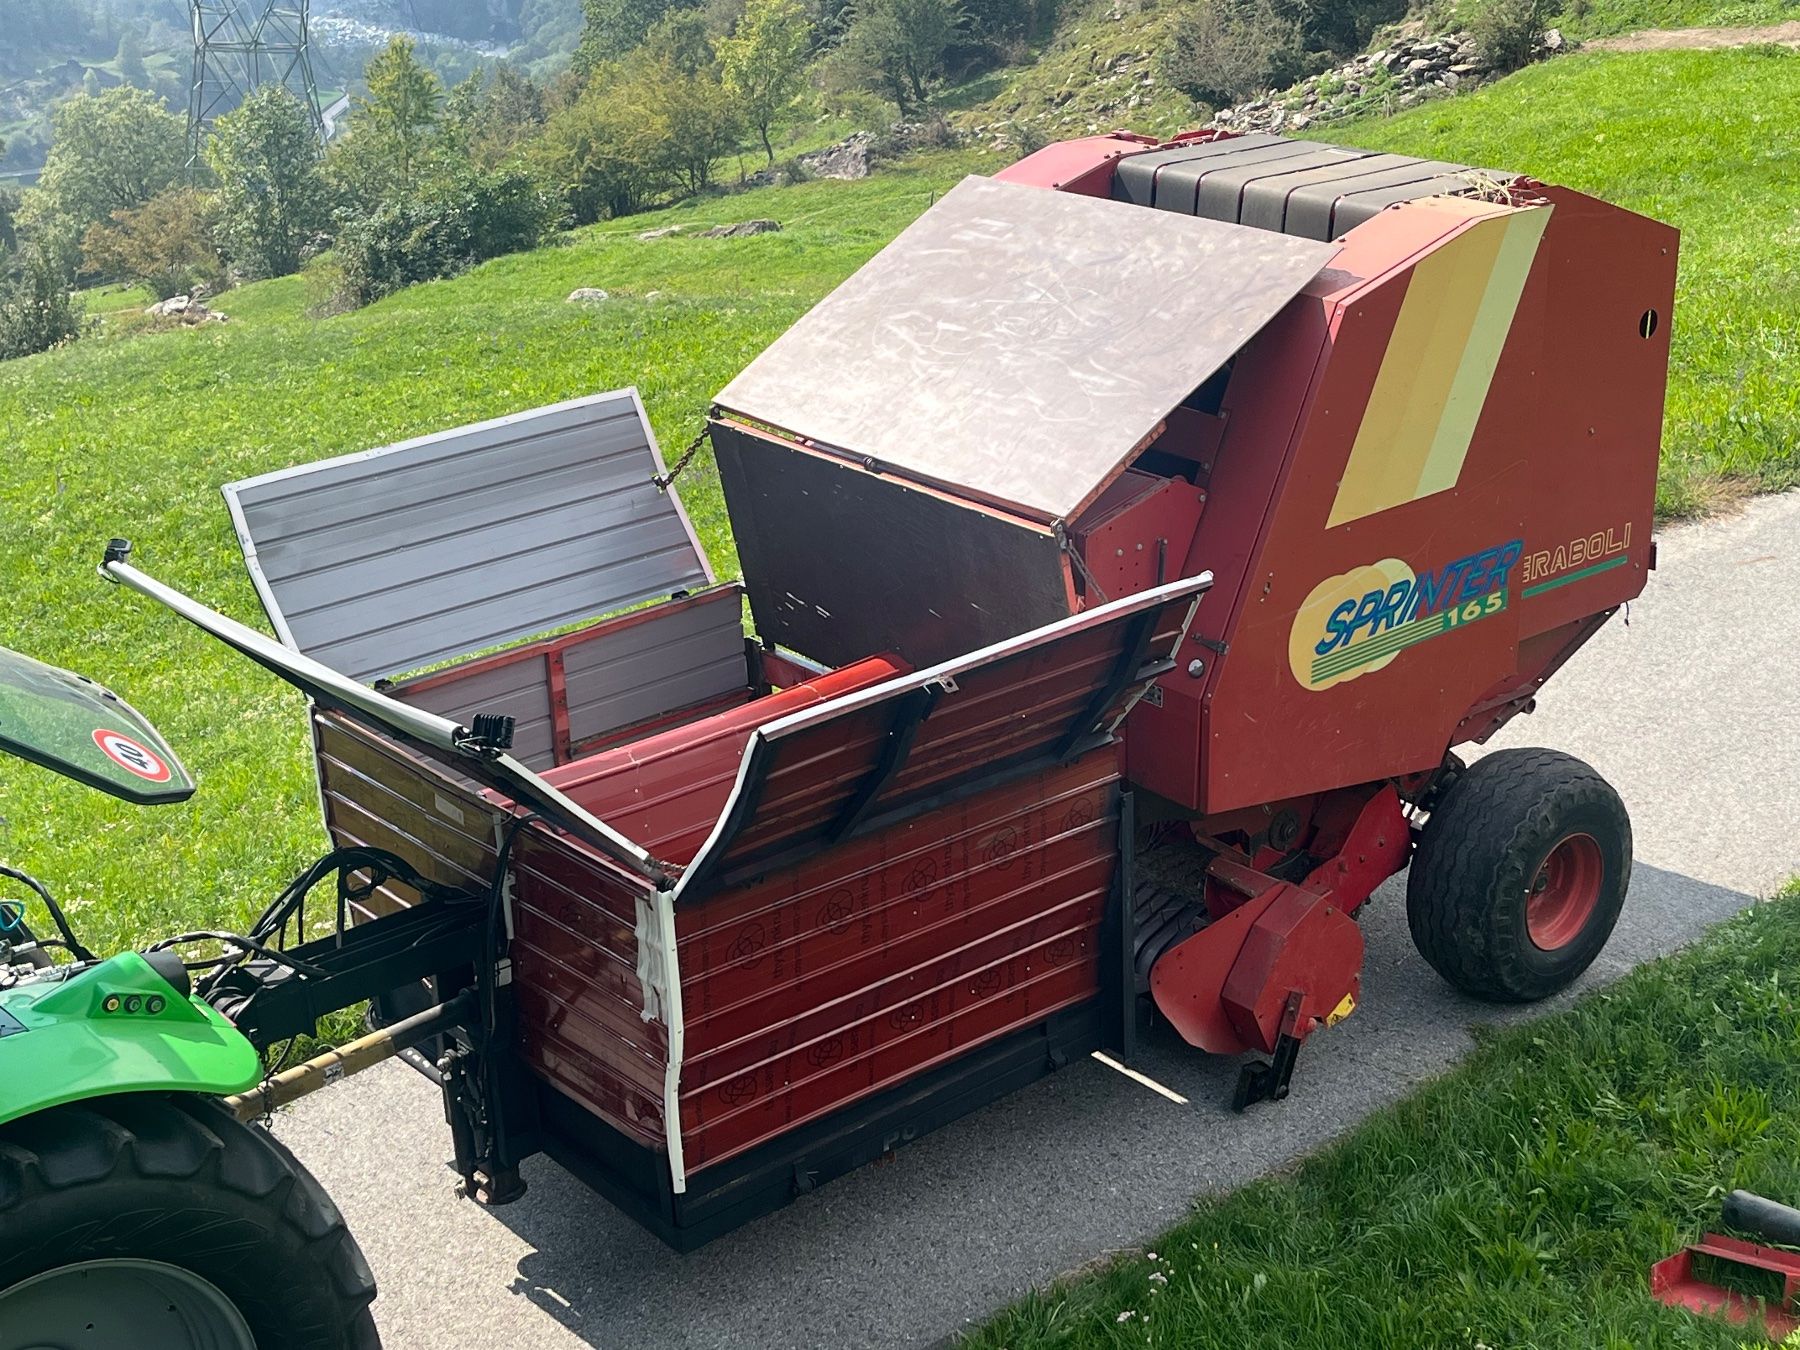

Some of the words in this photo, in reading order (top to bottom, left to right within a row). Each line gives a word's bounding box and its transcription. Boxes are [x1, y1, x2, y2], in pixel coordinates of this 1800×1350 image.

[1315, 538, 1524, 655] SPRINTER
[1447, 592, 1503, 626] 165
[115, 742, 150, 770] 40
